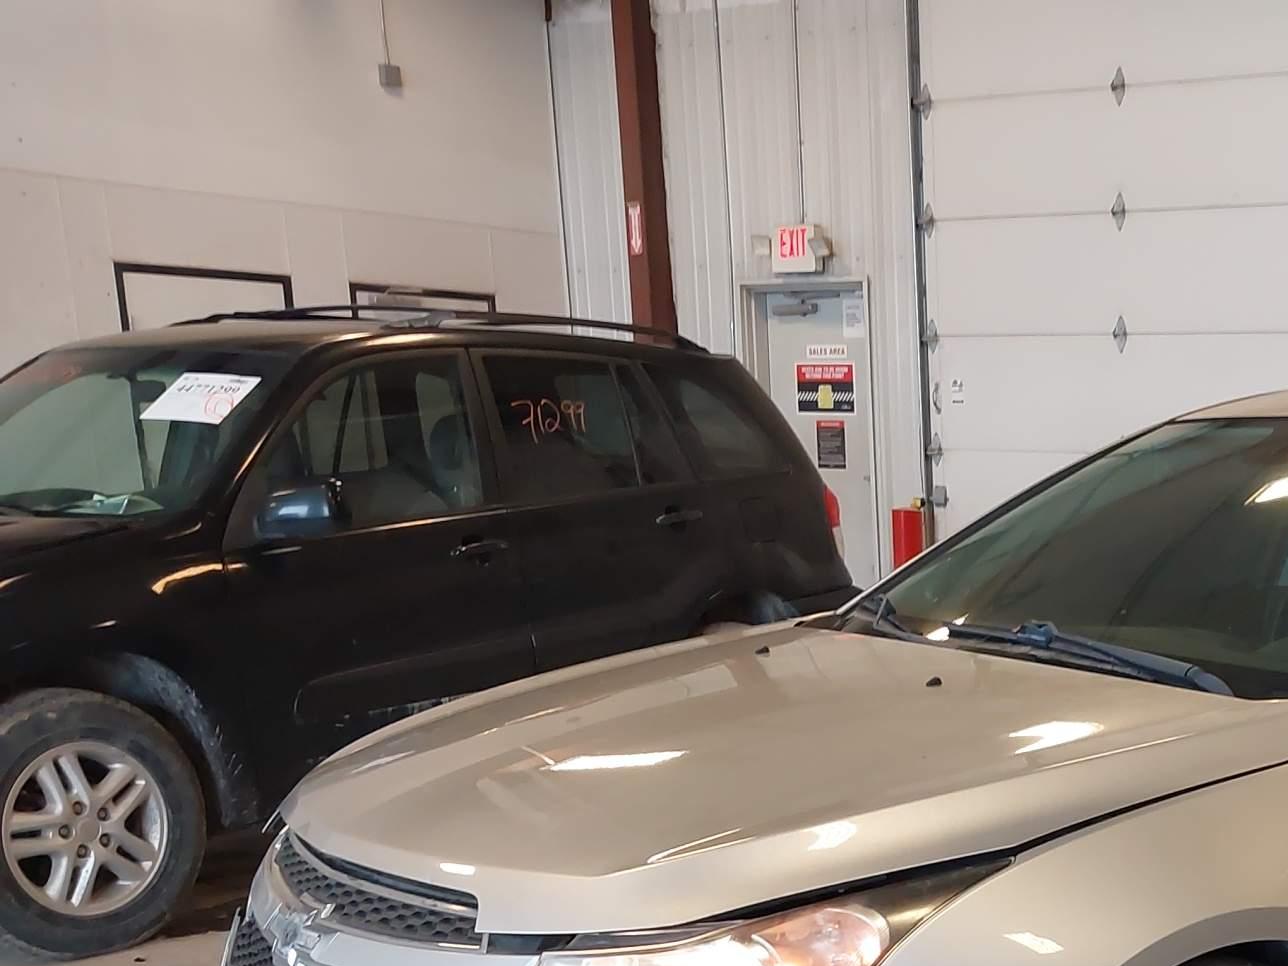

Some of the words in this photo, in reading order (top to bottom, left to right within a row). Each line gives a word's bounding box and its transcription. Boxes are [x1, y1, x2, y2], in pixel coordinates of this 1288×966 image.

[780, 228, 806, 258] EXIT
[809, 347, 827, 355] SALES
[510, 399, 586, 444] 71299
